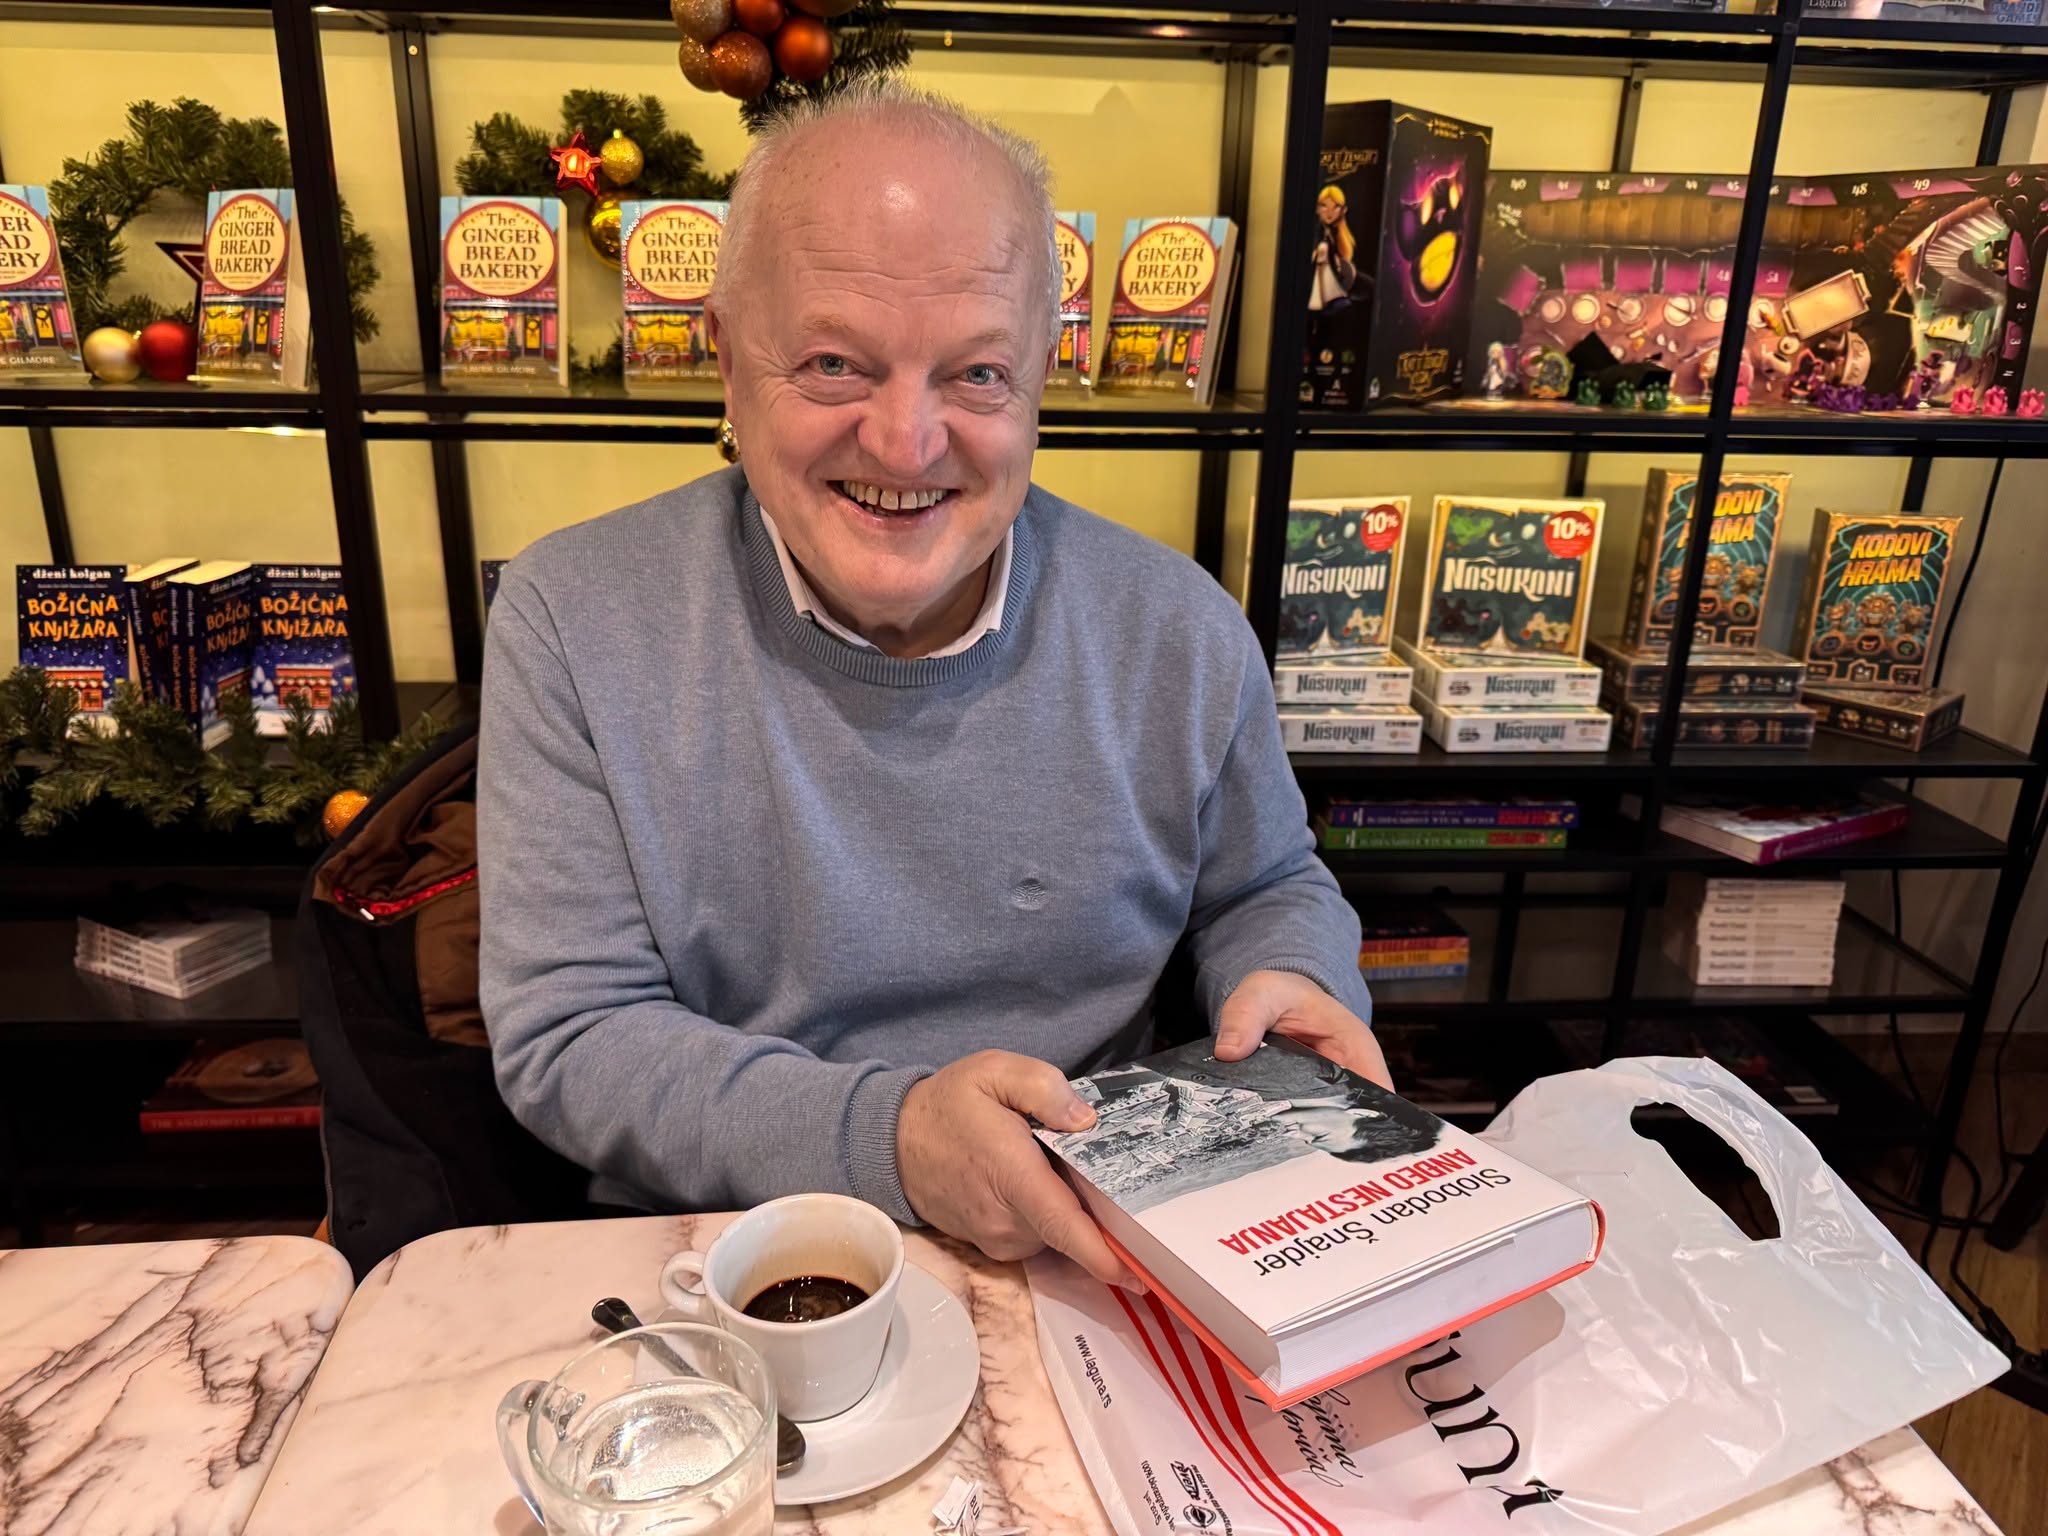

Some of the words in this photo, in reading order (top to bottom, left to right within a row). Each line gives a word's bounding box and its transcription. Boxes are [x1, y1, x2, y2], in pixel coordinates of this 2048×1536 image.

[1851, 183, 1868, 196] 48
[1913, 178, 1931, 190] 49
[236, 205, 258, 219] The
[487, 213, 517, 226] The
[219, 221, 275, 237] GINGER
[666, 217, 697, 230] The
[462, 228, 540, 244] GINGER
[642, 232, 719, 248] GINGER
[1161, 232, 1187, 245] The
[220, 240, 271, 255] BREAD
[466, 246, 537, 261] BREAD
[1136, 247, 1204, 262] GINGER
[0, 253, 40, 267] ERY
[215, 258, 275, 273] BAKERY
[647, 250, 716, 266] BREAD
[460, 263, 544, 279] BAKERY
[1136, 264, 1198, 279] BREAD
[1128, 281, 1202, 296] BAKERY
[1686, 489, 1765, 520] DOVI
[1366, 511, 1399, 534] 10%
[1549, 517, 1591, 540] 10%
[1849, 531, 1933, 559] KODOVI
[32, 567, 67, 579] dženi
[1838, 557, 1922, 587] HRAMA
[27, 592, 119, 616] BOŽIĆNA
[261, 591, 349, 616] BOŽIĆNA
[206, 600, 250, 631] BOŽIĆN
[28, 618, 119, 642] KNJIŽARA
[262, 618, 349, 641] KNJIŽARA
[1382, 1148, 1477, 1190] ANĐEO
[1370, 1168, 1511, 1225] Slobodan
[1217, 1180, 1394, 1255] NESTAJANJA
[1253, 1221, 1380, 1276] Šnajder
[1074, 1334, 1112, 1408] www.laguna.rs
[1405, 1331, 1564, 1520] una
[1141, 1460, 1153, 1478] 100%
